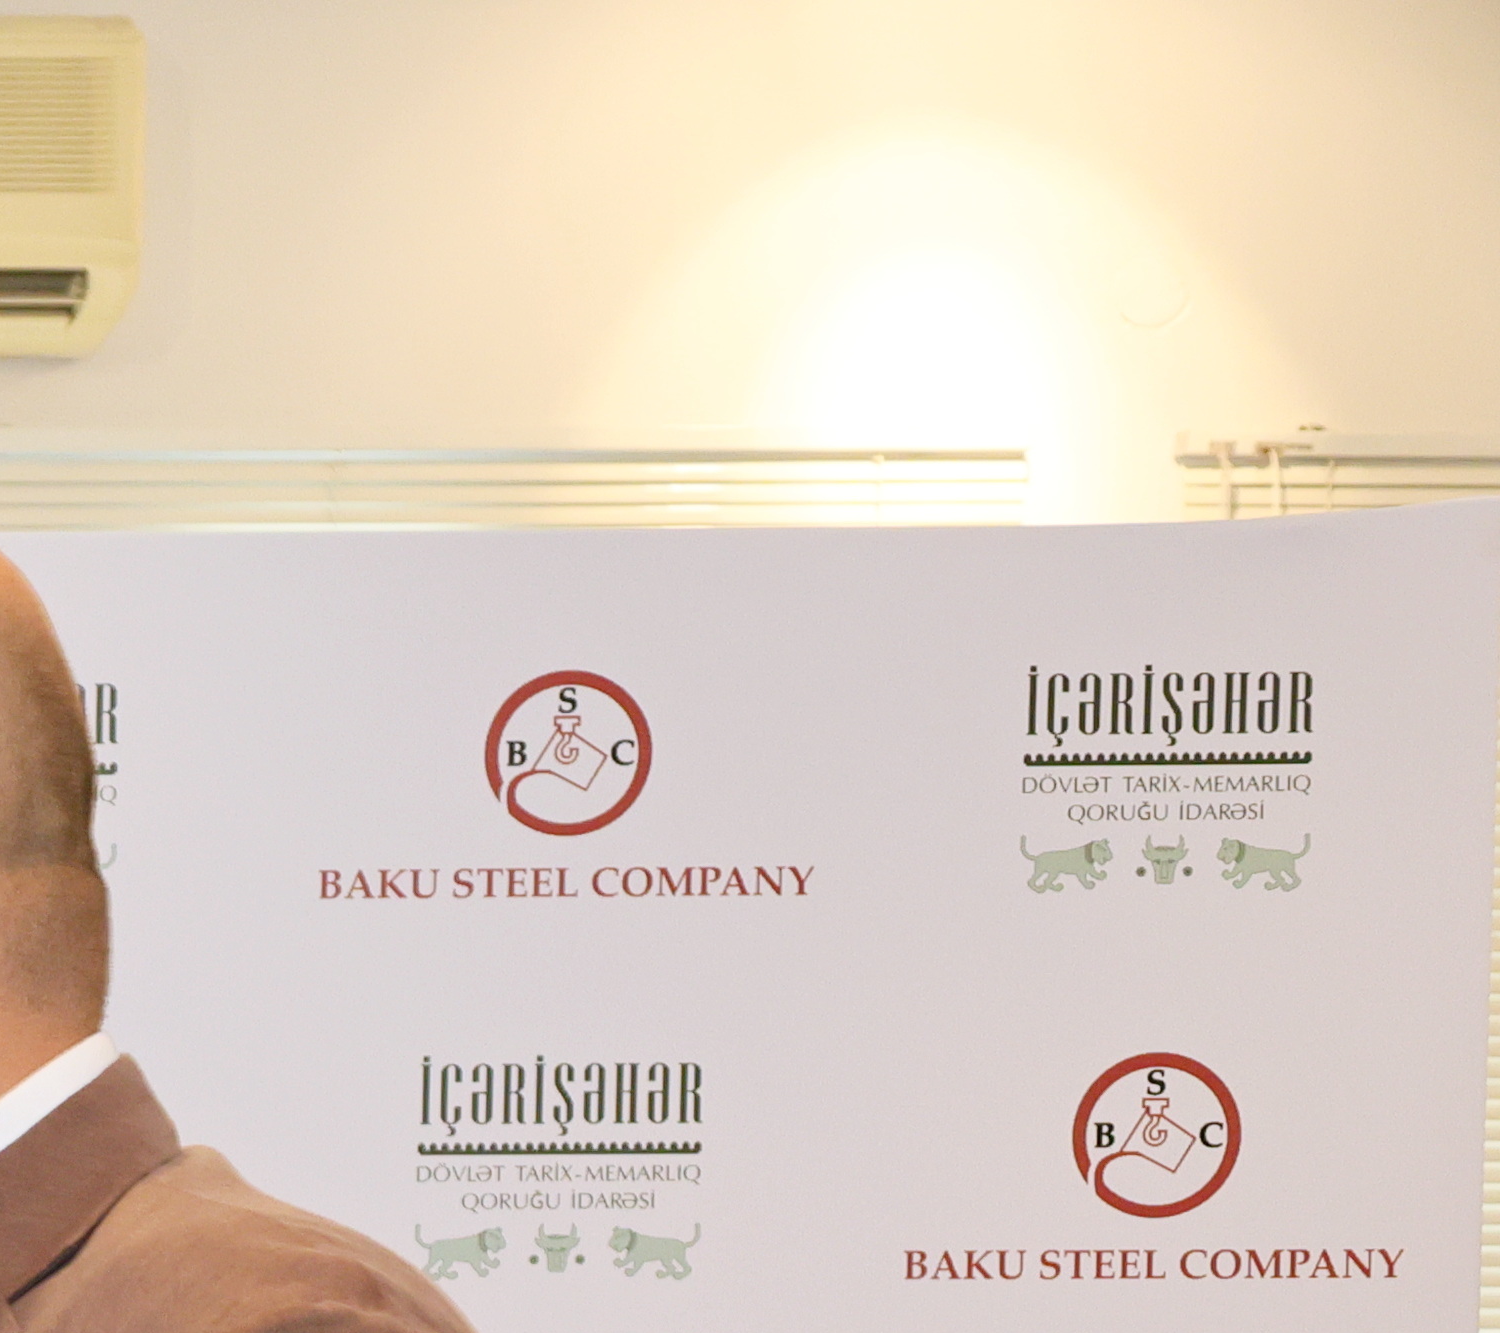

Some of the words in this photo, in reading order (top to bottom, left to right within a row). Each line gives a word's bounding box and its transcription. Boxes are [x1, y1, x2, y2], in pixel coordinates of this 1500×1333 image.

[559, 688, 577, 713] S
[508, 741, 526, 766] B
[611, 740, 634, 765] C
[1021, 773, 1113, 794] DÖVLƏT
[1067, 800, 1169, 826] QORUĞU
[319, 868, 440, 900] BAKU
[452, 867, 578, 899] STEEL
[591, 865, 815, 898] COMPANY
[1147, 1070, 1165, 1095] S
[1096, 1123, 1114, 1147] B
[1200, 1122, 1223, 1148] C
[416, 1162, 505, 1183] DÖVLƏT
[460, 1189, 561, 1214] QORUĞU
[904, 1249, 1027, 1281] BAKU
[1039, 1249, 1166, 1281] STEEL
[1179, 1248, 1404, 1280] COMPANY
